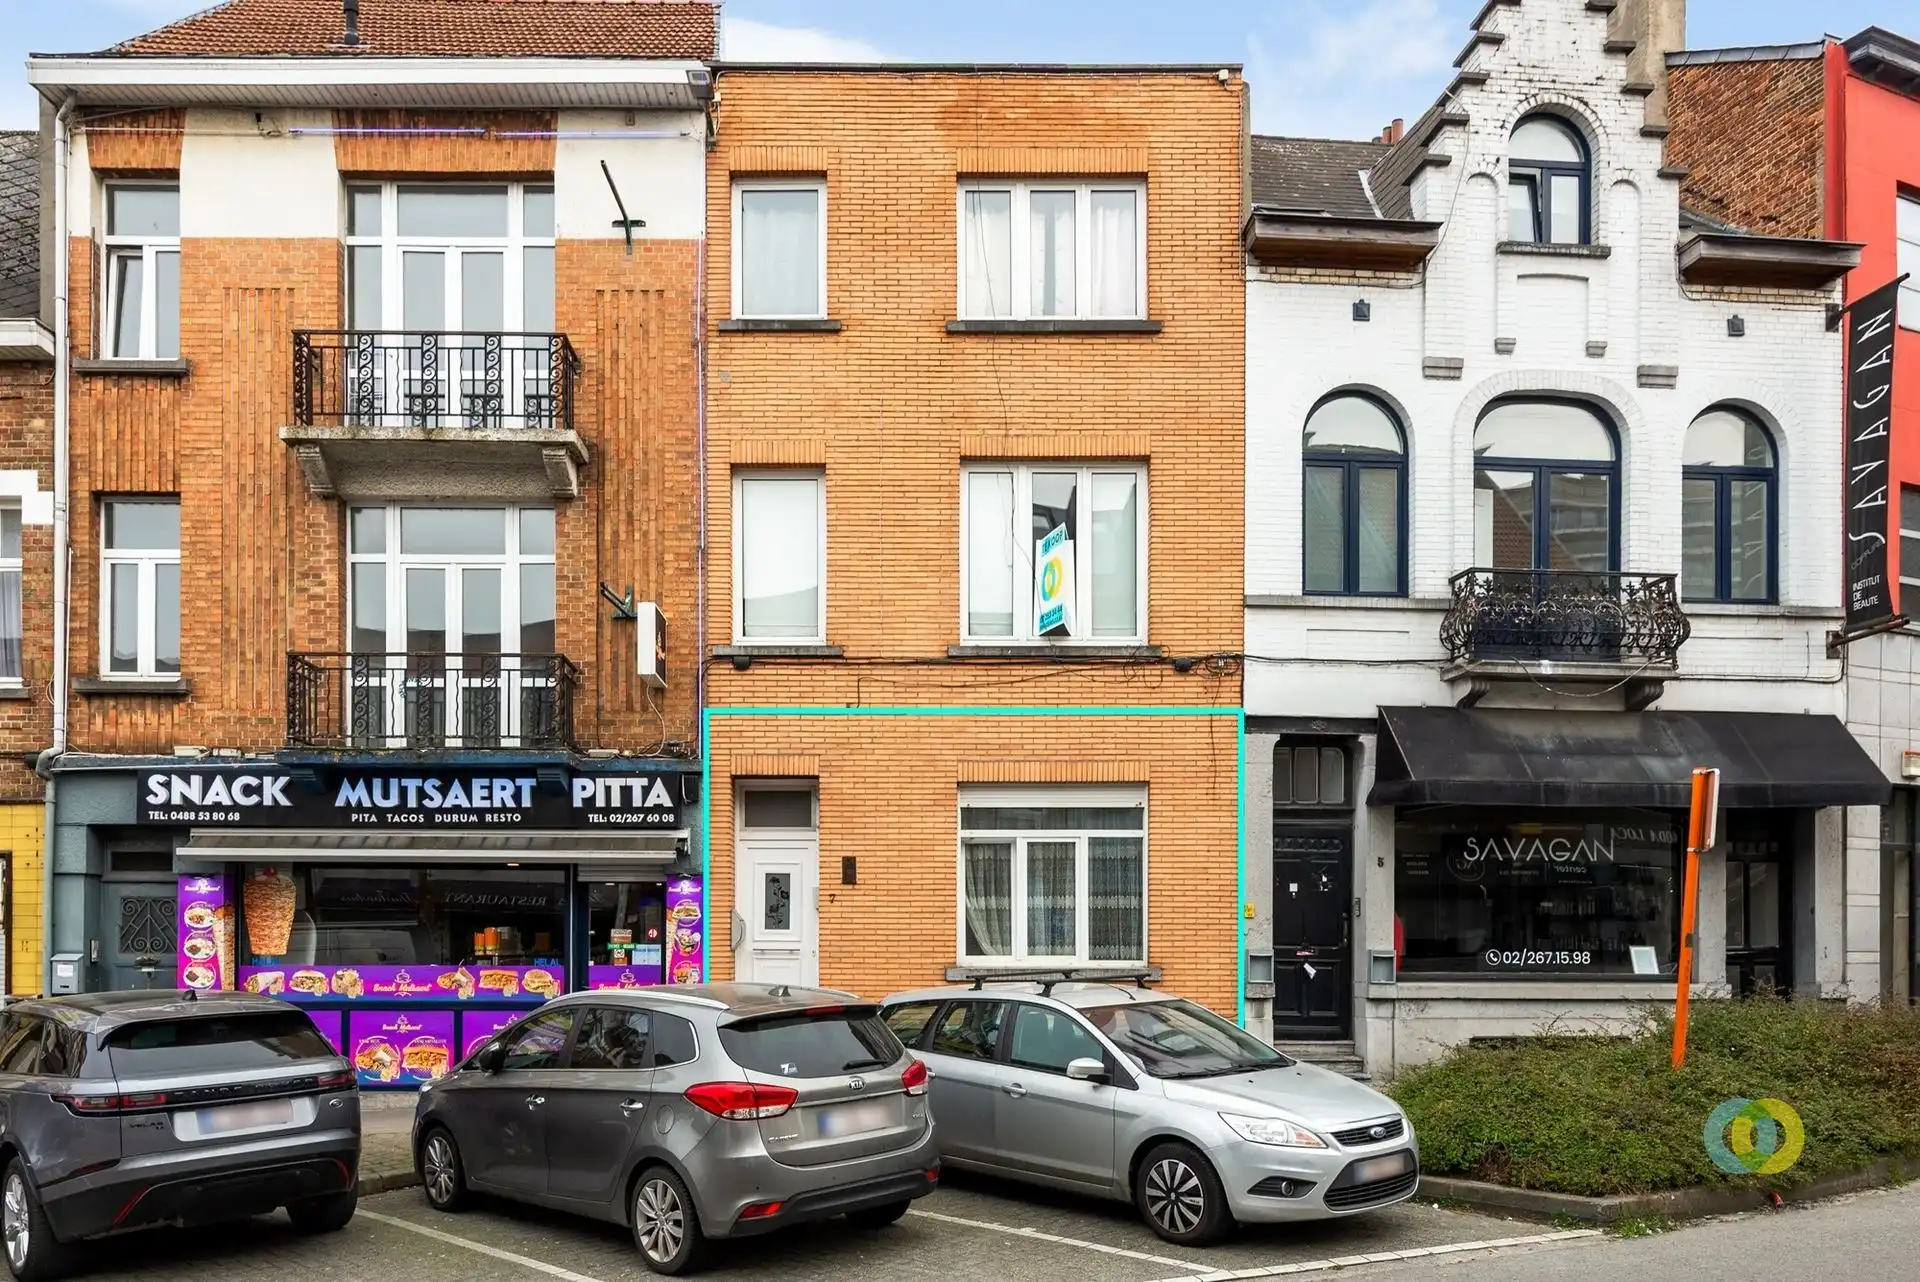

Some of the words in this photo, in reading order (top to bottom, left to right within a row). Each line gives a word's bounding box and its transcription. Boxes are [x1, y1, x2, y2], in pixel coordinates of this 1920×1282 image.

[1848, 308, 1893, 545] SAVAGAN
[1852, 574, 1881, 591] INSTITUT
[1852, 591, 1862, 602] DE
[1852, 595, 1880, 611] BEAUTE
[146, 773, 294, 807] SNACK
[334, 776, 537, 808] MUTSAERT
[572, 777, 674, 808] PITTA
[148, 811, 168, 820] TEL:
[170, 811, 196, 820] 0488
[198, 812, 211, 821] 53
[212, 812, 225, 821] 80
[227, 812, 240, 821] 68
[351, 813, 378, 823] PITA
[386, 813, 425, 823] TACOS
[434, 813, 479, 823] DURUM
[485, 813, 522, 823] RESTO
[588, 813, 607, 823] TEL:
[609, 813, 644, 823] 02/267
[646, 814, 660, 823] 60
[661, 814, 675, 823] 08
[1463, 837, 1614, 862] SAVAGAN
[1377, 856, 1384, 868] 5
[828, 893, 836, 904] 7
[1502, 948, 1591, 967] 02/267.15.98
[850, 1080, 864, 1089] KIA
